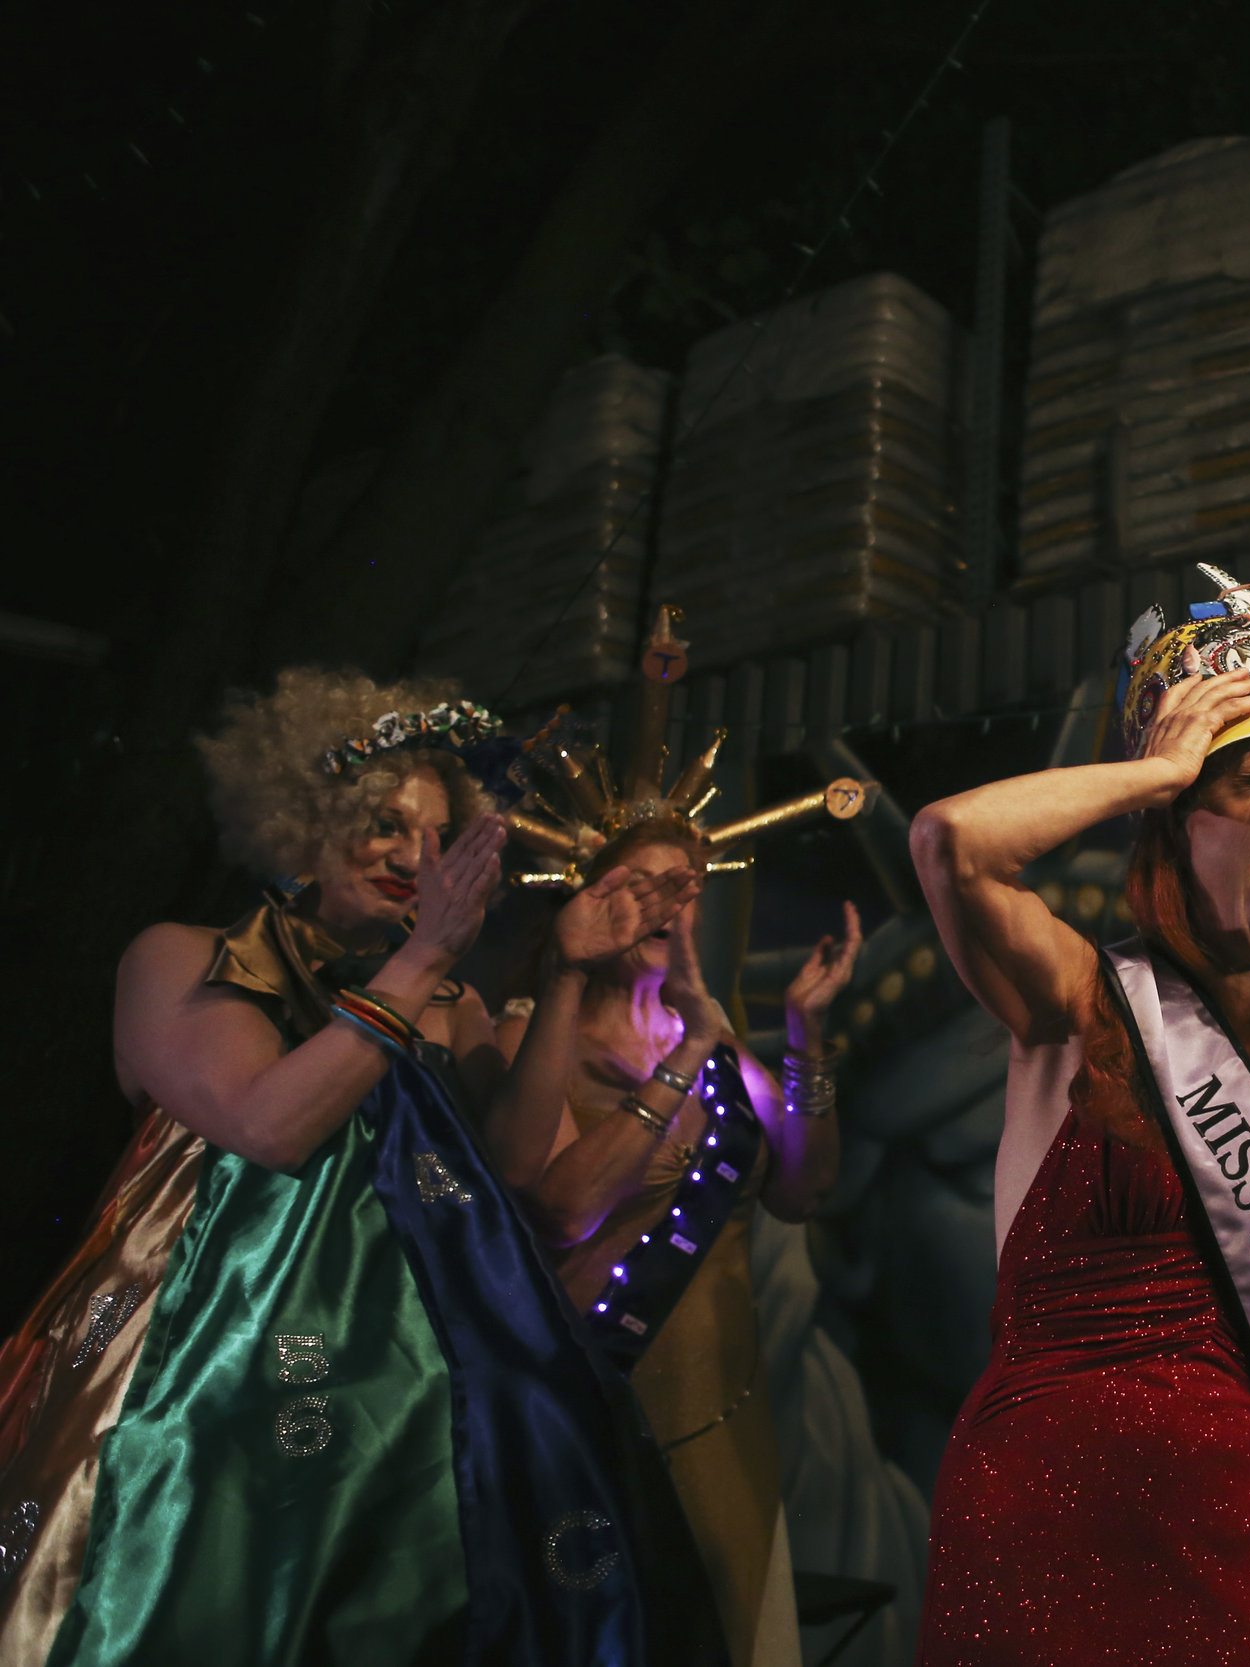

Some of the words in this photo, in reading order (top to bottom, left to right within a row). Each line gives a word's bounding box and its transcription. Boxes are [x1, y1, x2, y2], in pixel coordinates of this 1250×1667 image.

[652, 652, 681, 678] T
[413, 1151, 474, 1204] A
[542, 1510, 620, 1590] C
